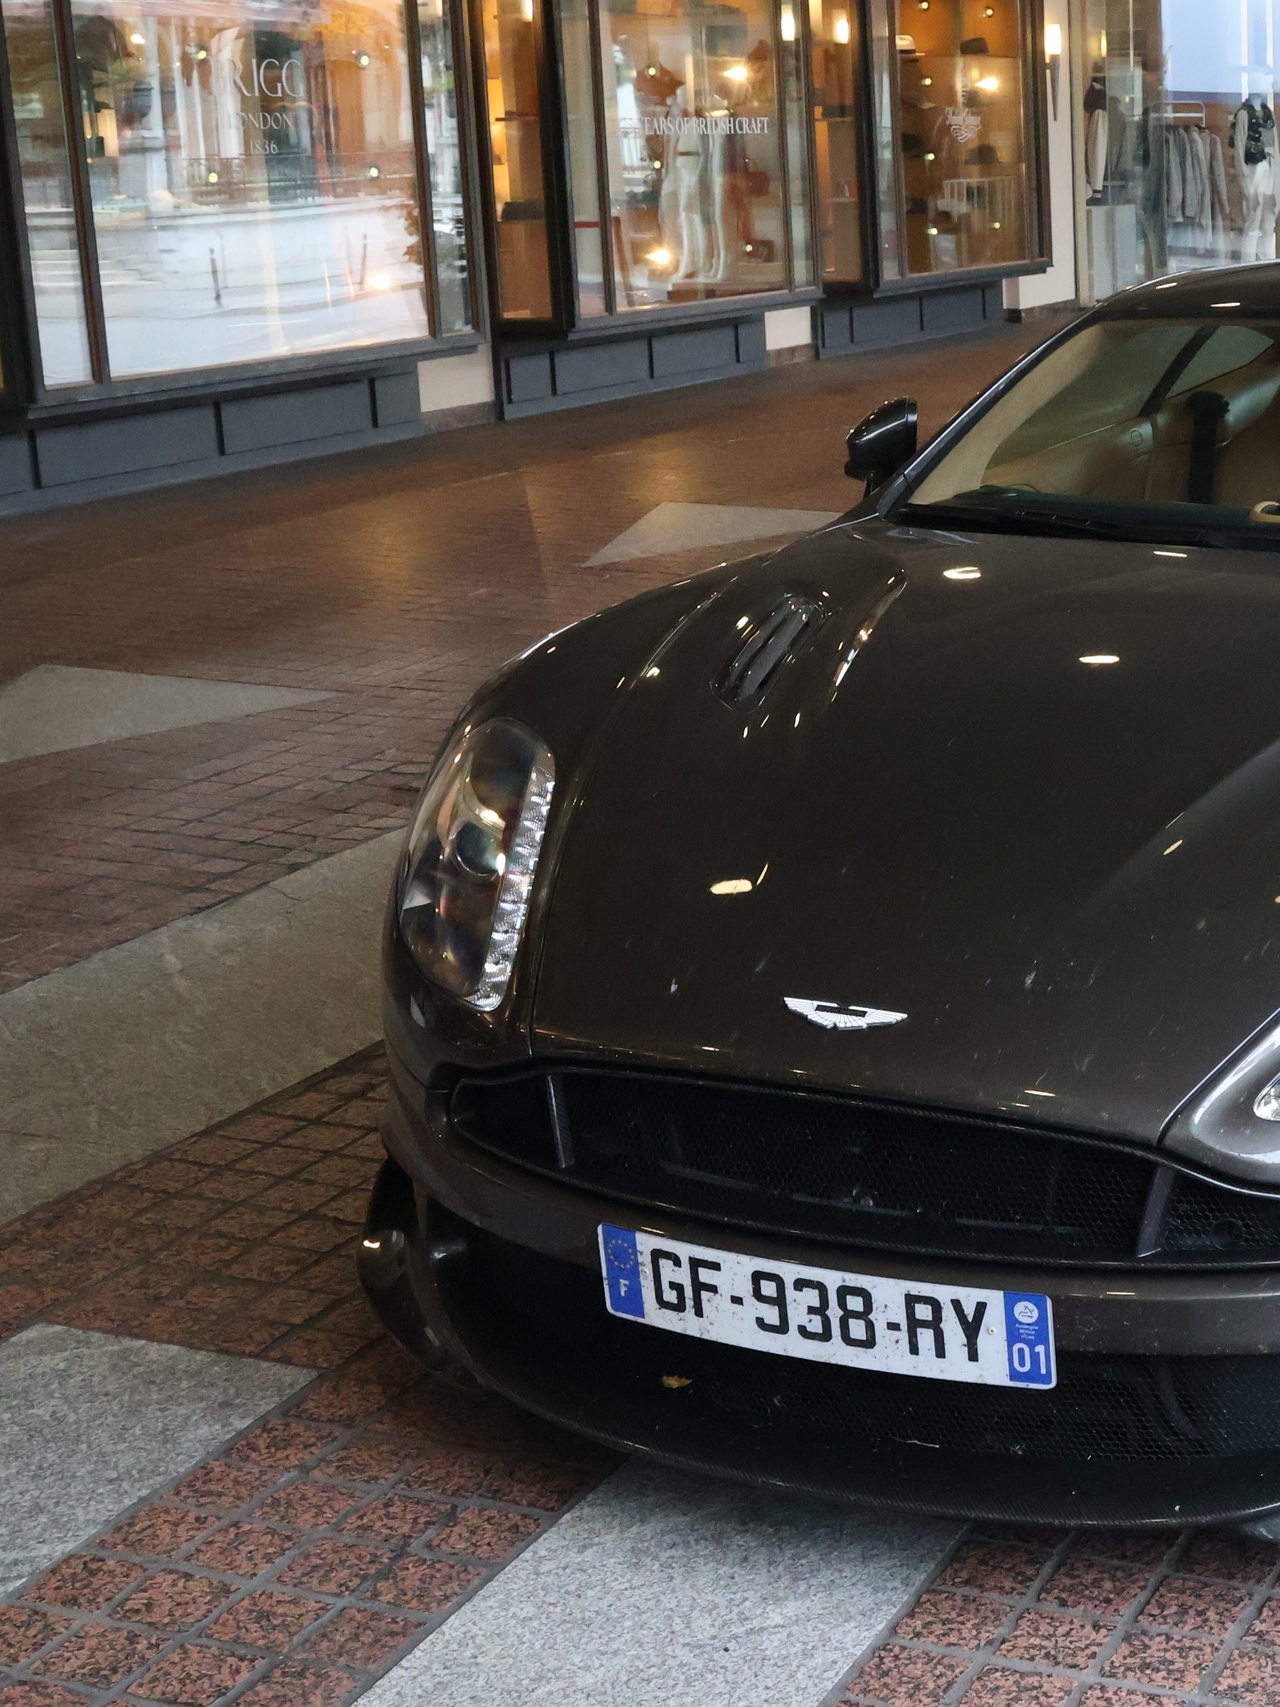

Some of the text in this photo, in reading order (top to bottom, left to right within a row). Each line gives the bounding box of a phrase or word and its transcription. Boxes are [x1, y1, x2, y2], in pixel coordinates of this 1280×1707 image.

[213, 58, 305, 98] RIGG
[735, 116, 770, 135] CRAFT
[250, 140, 279, 155] 1836
[619, 1279, 630, 1297] F
[649, 1248, 989, 1363] GF-938-RY
[1012, 1342, 1047, 1375] 01
